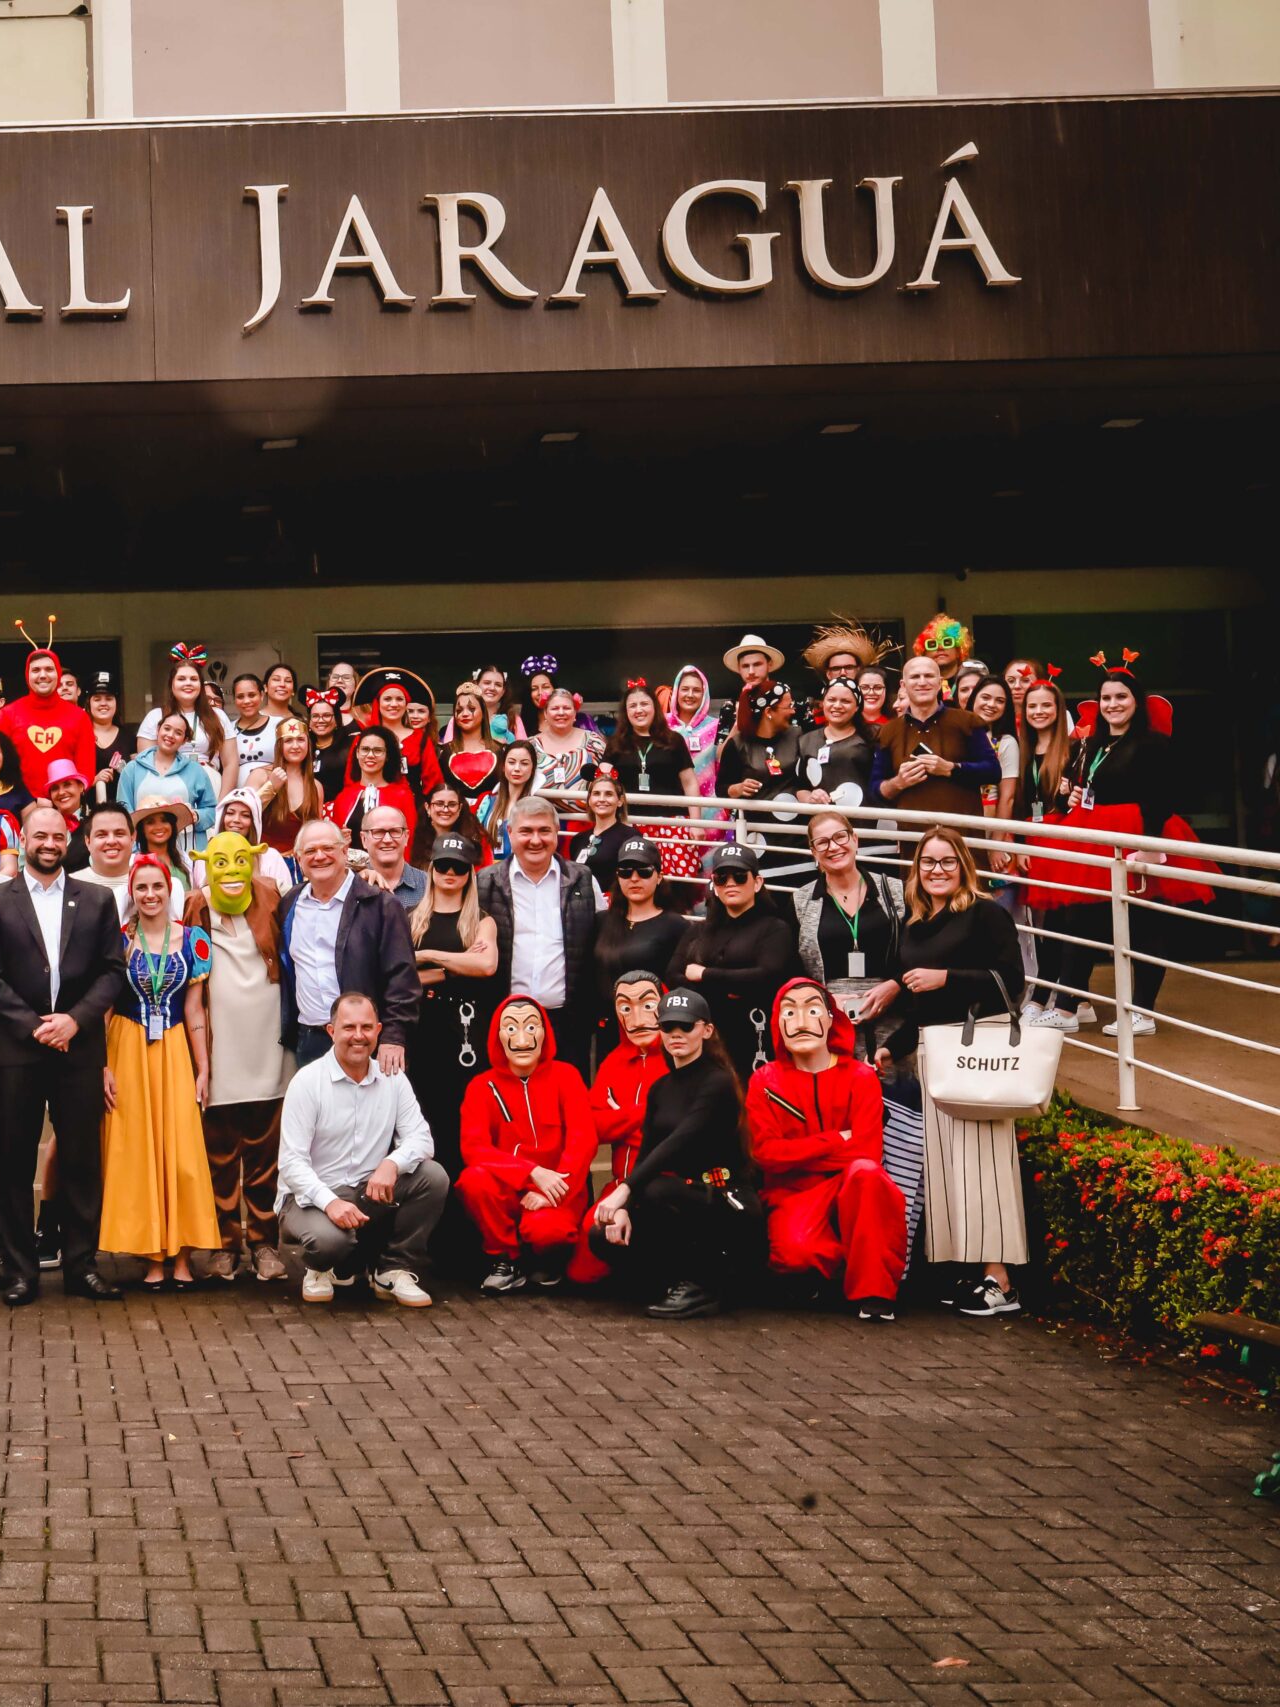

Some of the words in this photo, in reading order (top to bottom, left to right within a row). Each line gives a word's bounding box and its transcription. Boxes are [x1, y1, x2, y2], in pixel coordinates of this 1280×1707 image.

[243, 141, 1023, 333] JARAGUÁ
[35, 732, 54, 744] CH
[443, 839, 463, 850] FBI
[625, 841, 645, 851] FBI
[721, 846, 742, 857] FBI
[666, 995, 689, 1007] FBI
[956, 1056, 1019, 1071] SCHUTZ
